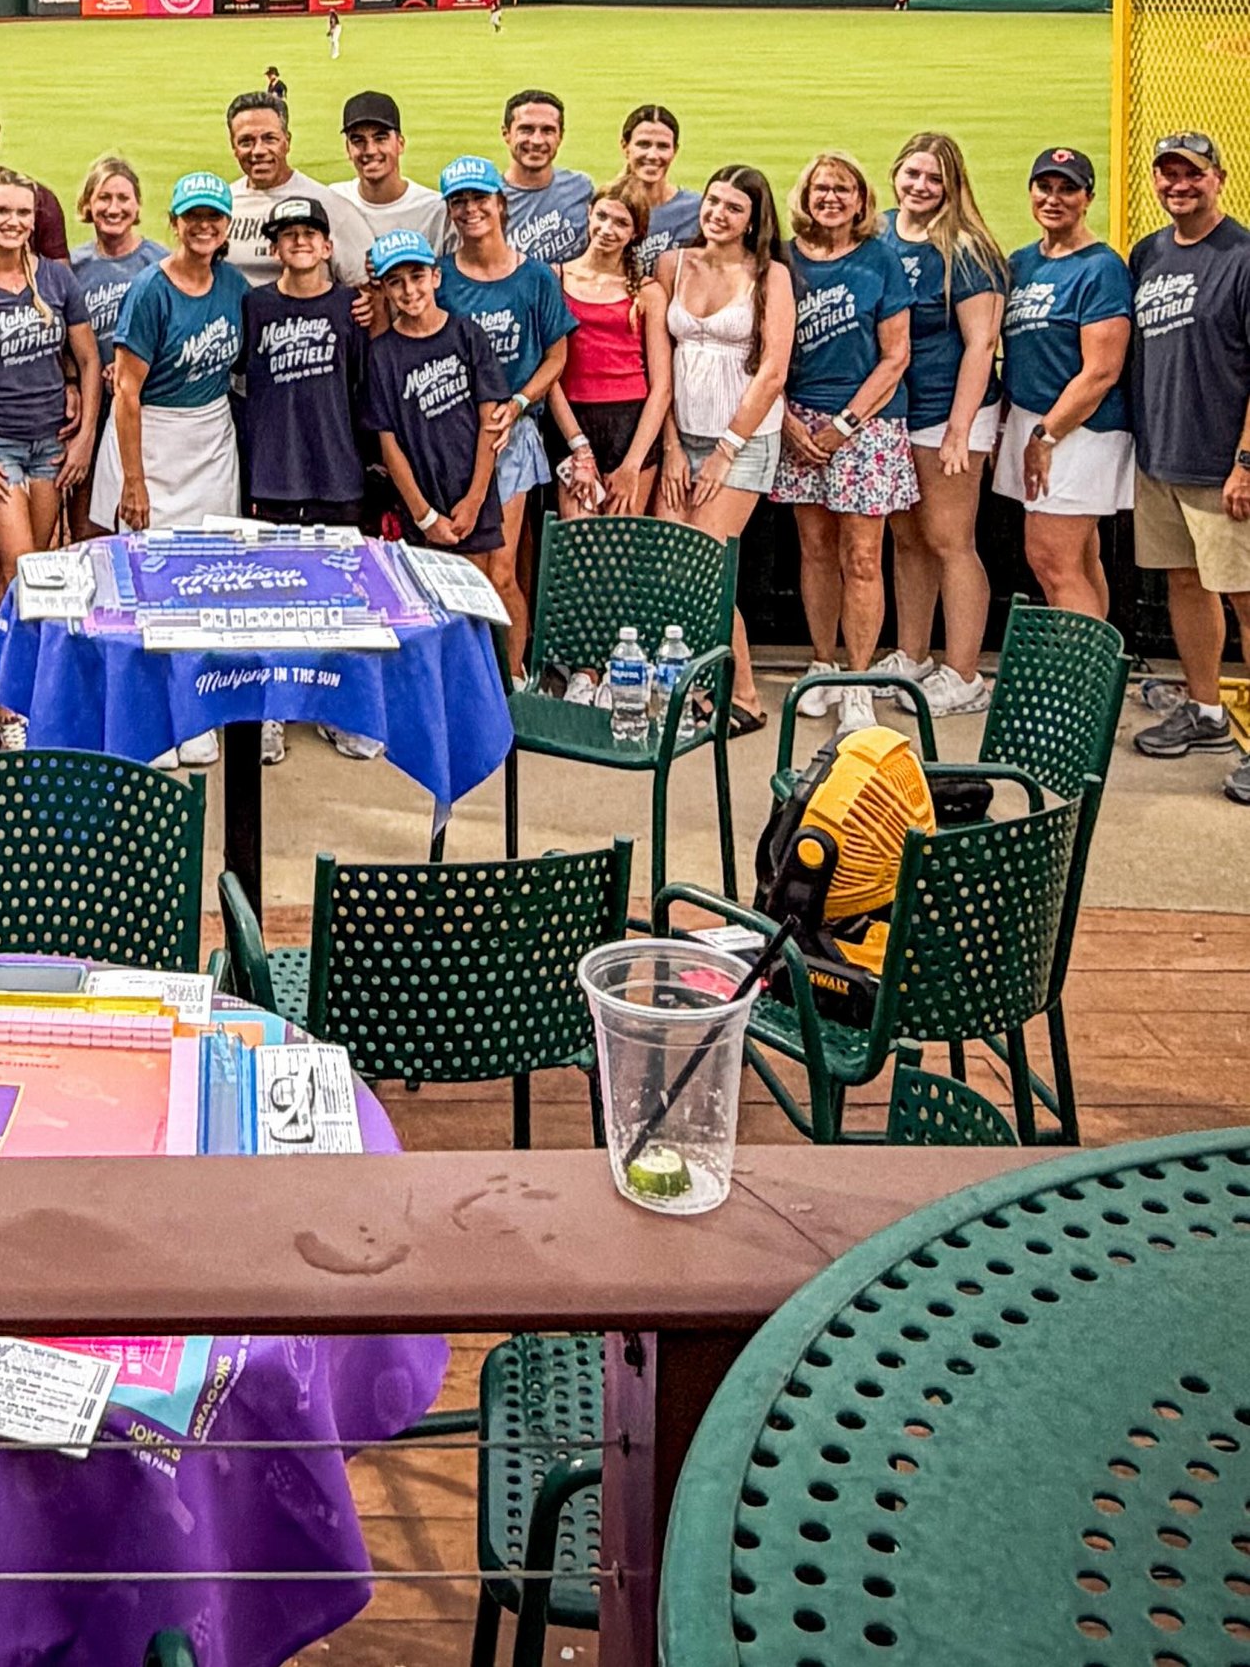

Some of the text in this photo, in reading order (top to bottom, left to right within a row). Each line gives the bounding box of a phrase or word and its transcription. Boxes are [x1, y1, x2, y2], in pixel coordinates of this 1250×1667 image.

[183, 176, 224, 193] MAHJ
[446, 161, 486, 182] MAHJ
[379, 232, 420, 254] MAHJ
[797, 283, 849, 325] ahjong
[257, 316, 332, 355] Mahjong
[796, 303, 856, 345] OUTFIELD
[0, 326, 62, 357] OUTFIELD
[270, 344, 335, 374] OUTFIELD
[403, 355, 461, 400] Mahjong
[419, 374, 468, 412] OUTFIELD
[179, 577, 307, 596] IN THE SUN
[195, 667, 341, 697] Mahjong IN THE SUN
